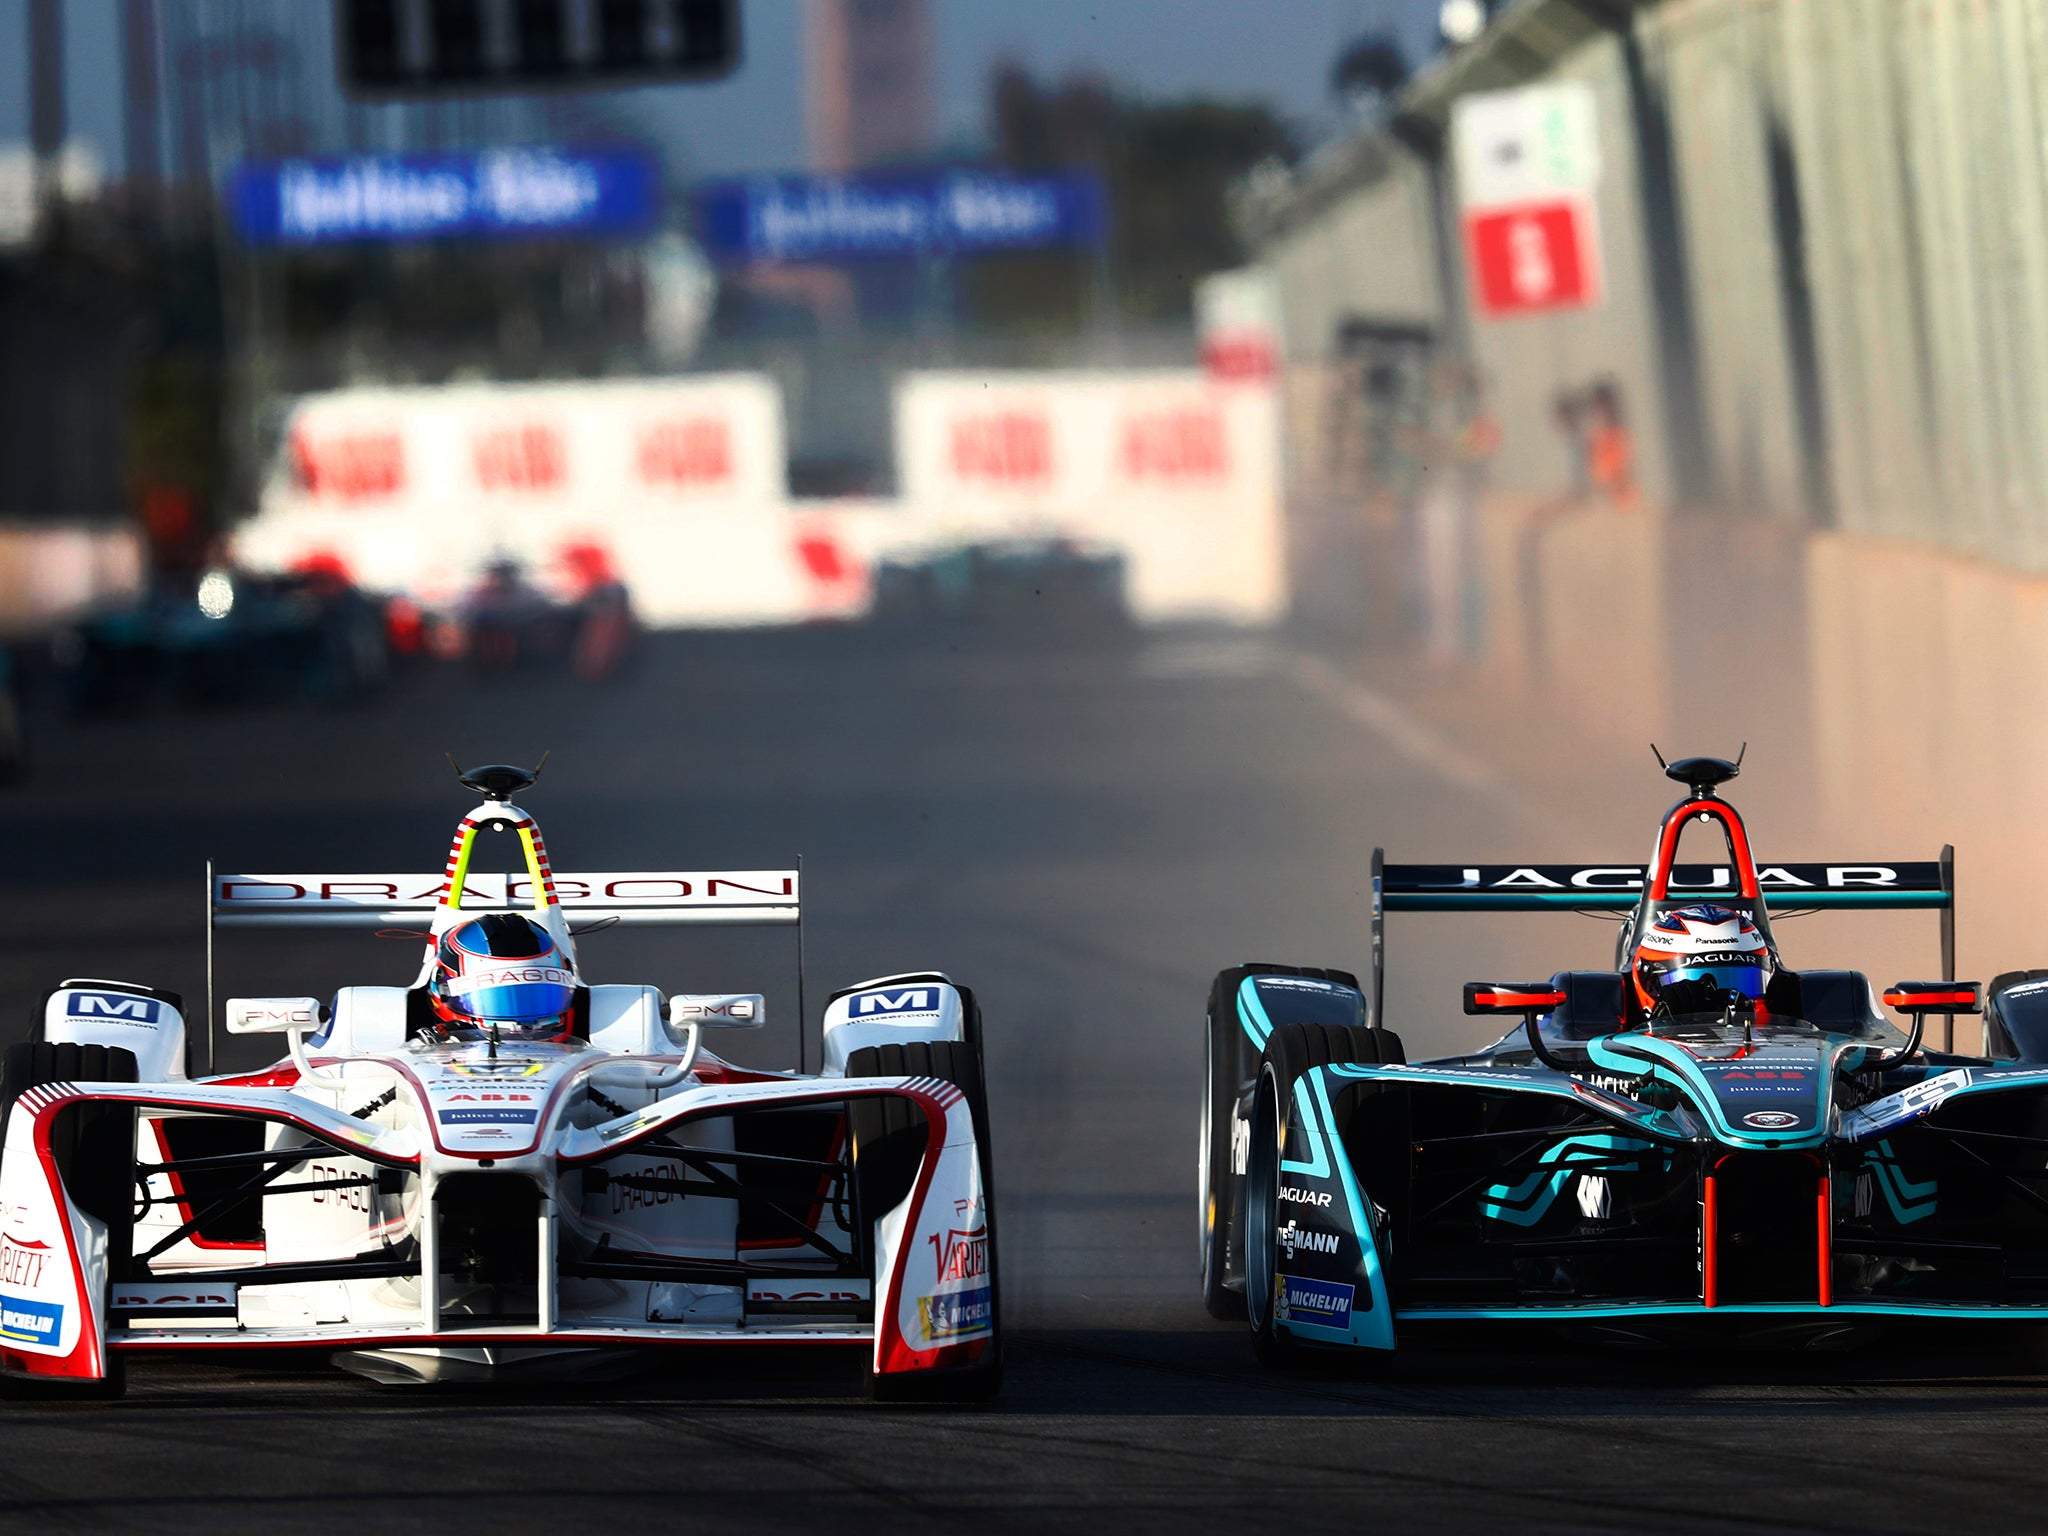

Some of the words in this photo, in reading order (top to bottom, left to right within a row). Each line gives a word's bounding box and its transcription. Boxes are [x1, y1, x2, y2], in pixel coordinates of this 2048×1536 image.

[1418, 867, 1898, 888] JAGUAR
[221, 878, 793, 900] DRAGON
[1695, 936, 1740, 945] Panasonic
[1679, 953, 1758, 967] JAGUAR
[245, 1010, 312, 1023] PMC
[682, 1004, 749, 1017] PMC
[846, 1012, 941, 1026] mouser.com
[1378, 1063, 1532, 1081] Panasonic
[1721, 1071, 1806, 1080] ABB
[446, 1094, 534, 1102] ABB
[1278, 1187, 1333, 1209] JAGUAR
[928, 1229, 989, 1285] VARIET
[1290, 1290, 1350, 1313] MICHELIN
